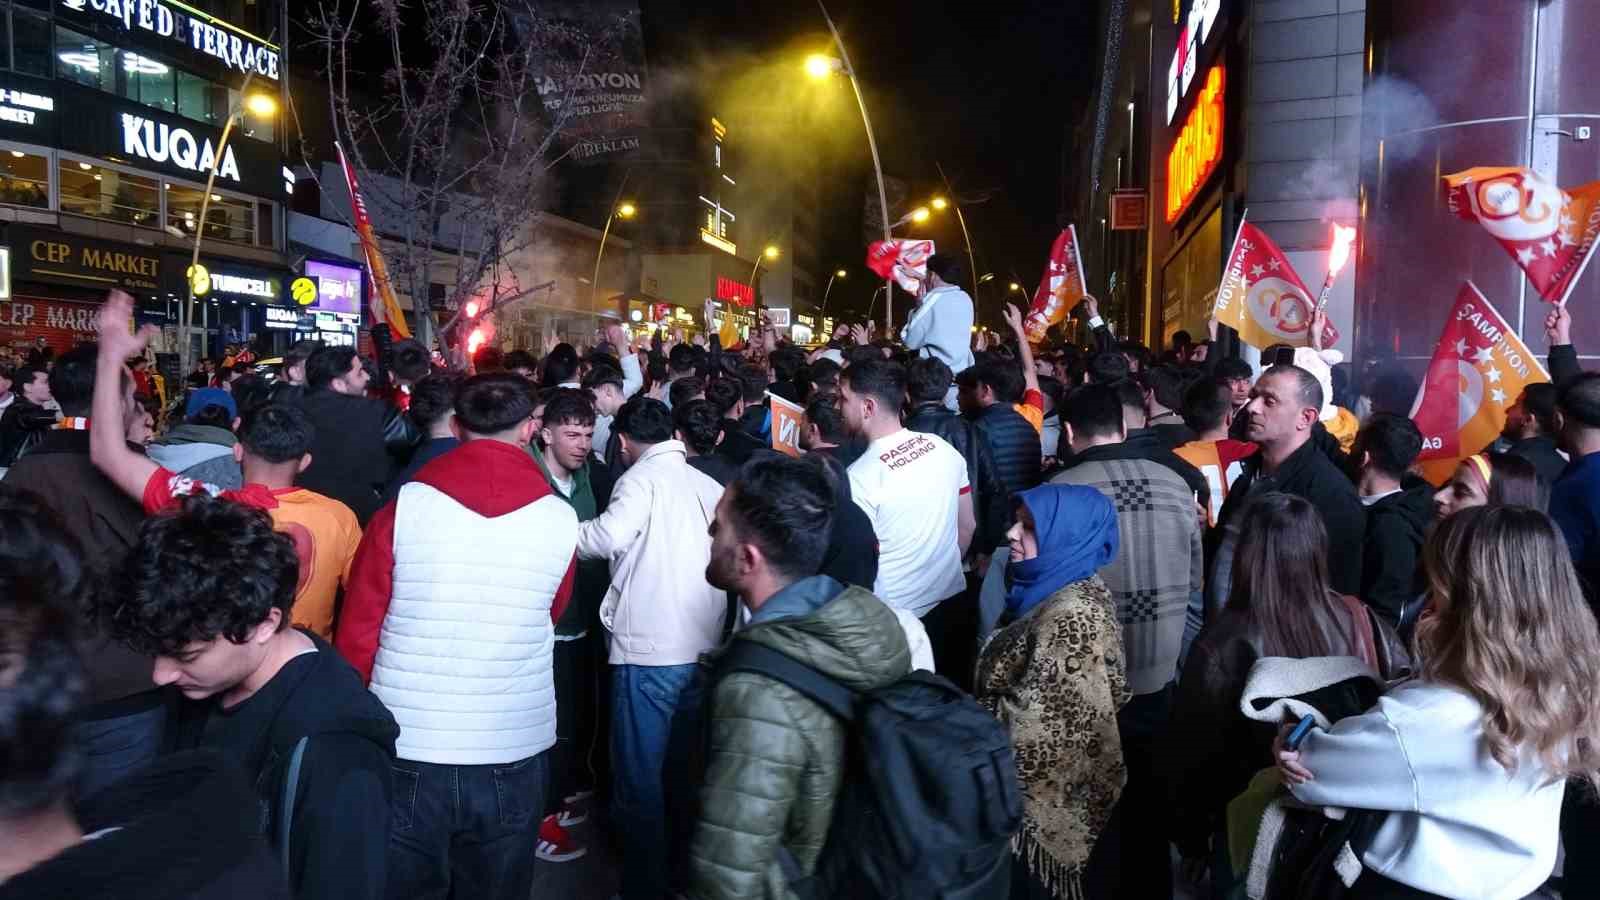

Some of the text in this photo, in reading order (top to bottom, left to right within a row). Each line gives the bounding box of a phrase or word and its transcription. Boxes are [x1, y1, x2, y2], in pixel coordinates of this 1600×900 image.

[189, 18, 280, 80] TERRACE
[122, 113, 240, 182] KUQAA
[31, 240, 160, 277] CEP MARKET
